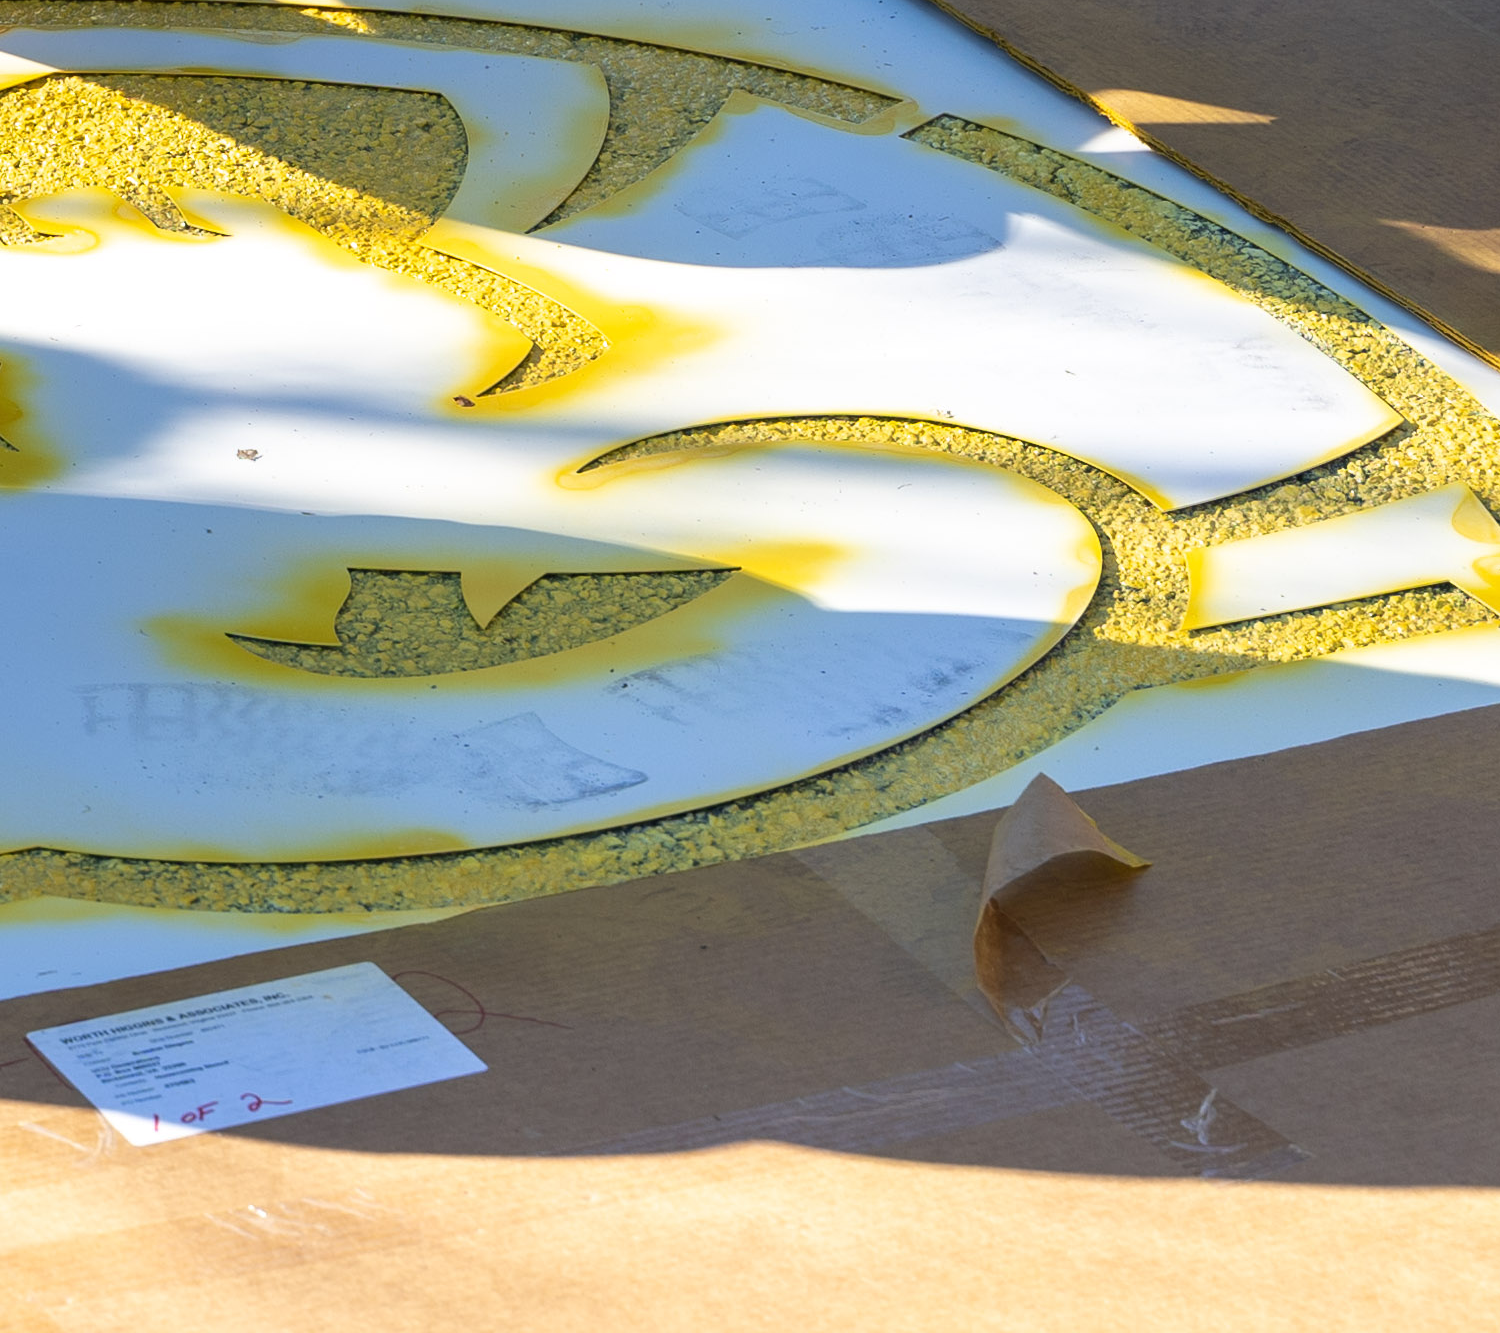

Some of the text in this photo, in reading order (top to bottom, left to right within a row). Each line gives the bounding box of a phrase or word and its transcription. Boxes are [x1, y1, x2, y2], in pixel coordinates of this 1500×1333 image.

[60, 1030, 109, 1045] WORTH
[110, 1018, 164, 1034] HIGGINS
[179, 997, 264, 1020] ASSOCIATES,
[263, 991, 291, 1002] INC.
[240, 1092, 294, 1113] 2
